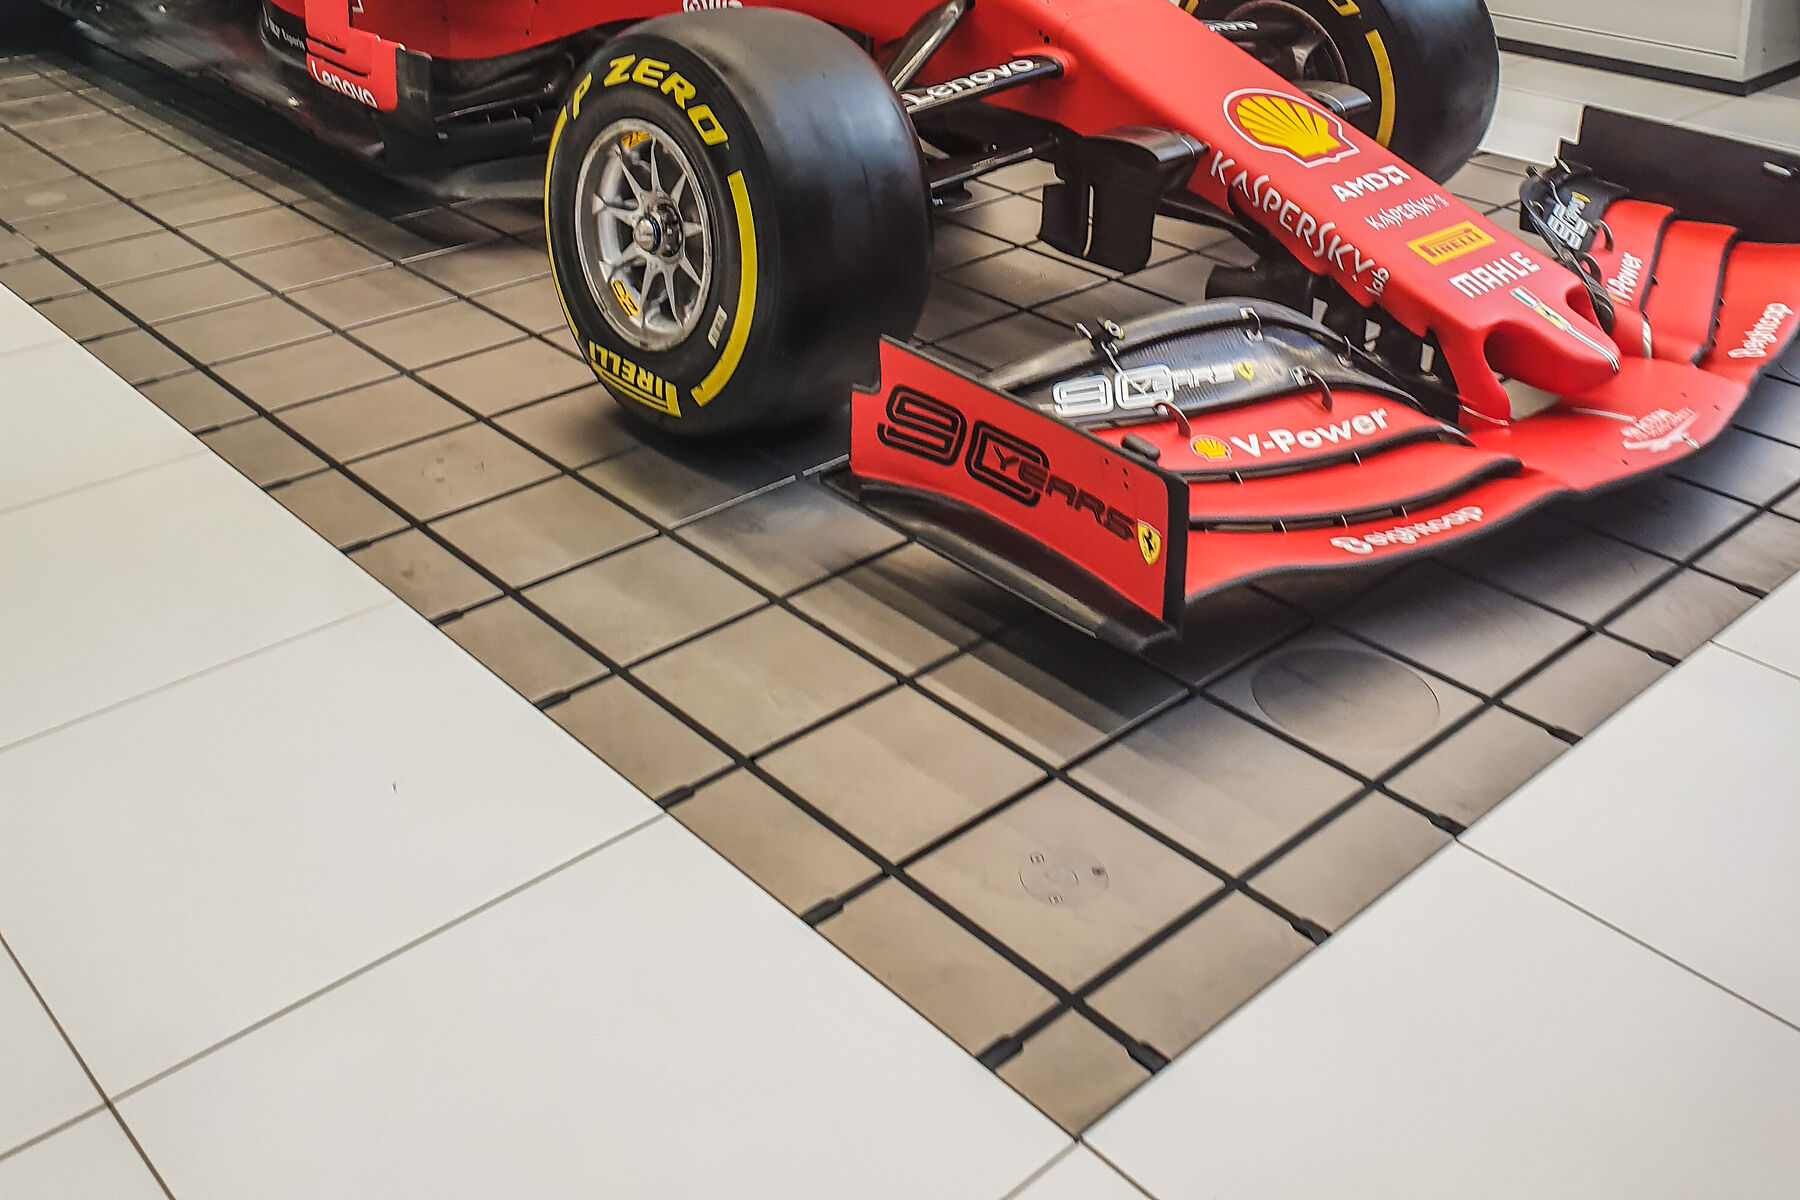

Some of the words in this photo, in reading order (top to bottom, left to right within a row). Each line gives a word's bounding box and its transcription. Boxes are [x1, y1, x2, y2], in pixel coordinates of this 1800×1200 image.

[310, 59, 379, 109] Lenovo
[572, 72, 592, 120] P
[603, 53, 729, 146] ZERO
[900, 59, 1036, 106] Lenovo
[1331, 172, 1391, 202] AMD
[1210, 150, 1376, 283] KASPERSKY
[1447, 250, 1541, 298] MAHLE
[589, 340, 682, 418] PIRELLI
[1229, 407, 1389, 458] V-Power
[877, 385, 1050, 507] 90
[993, 444, 1136, 541] YEARS
